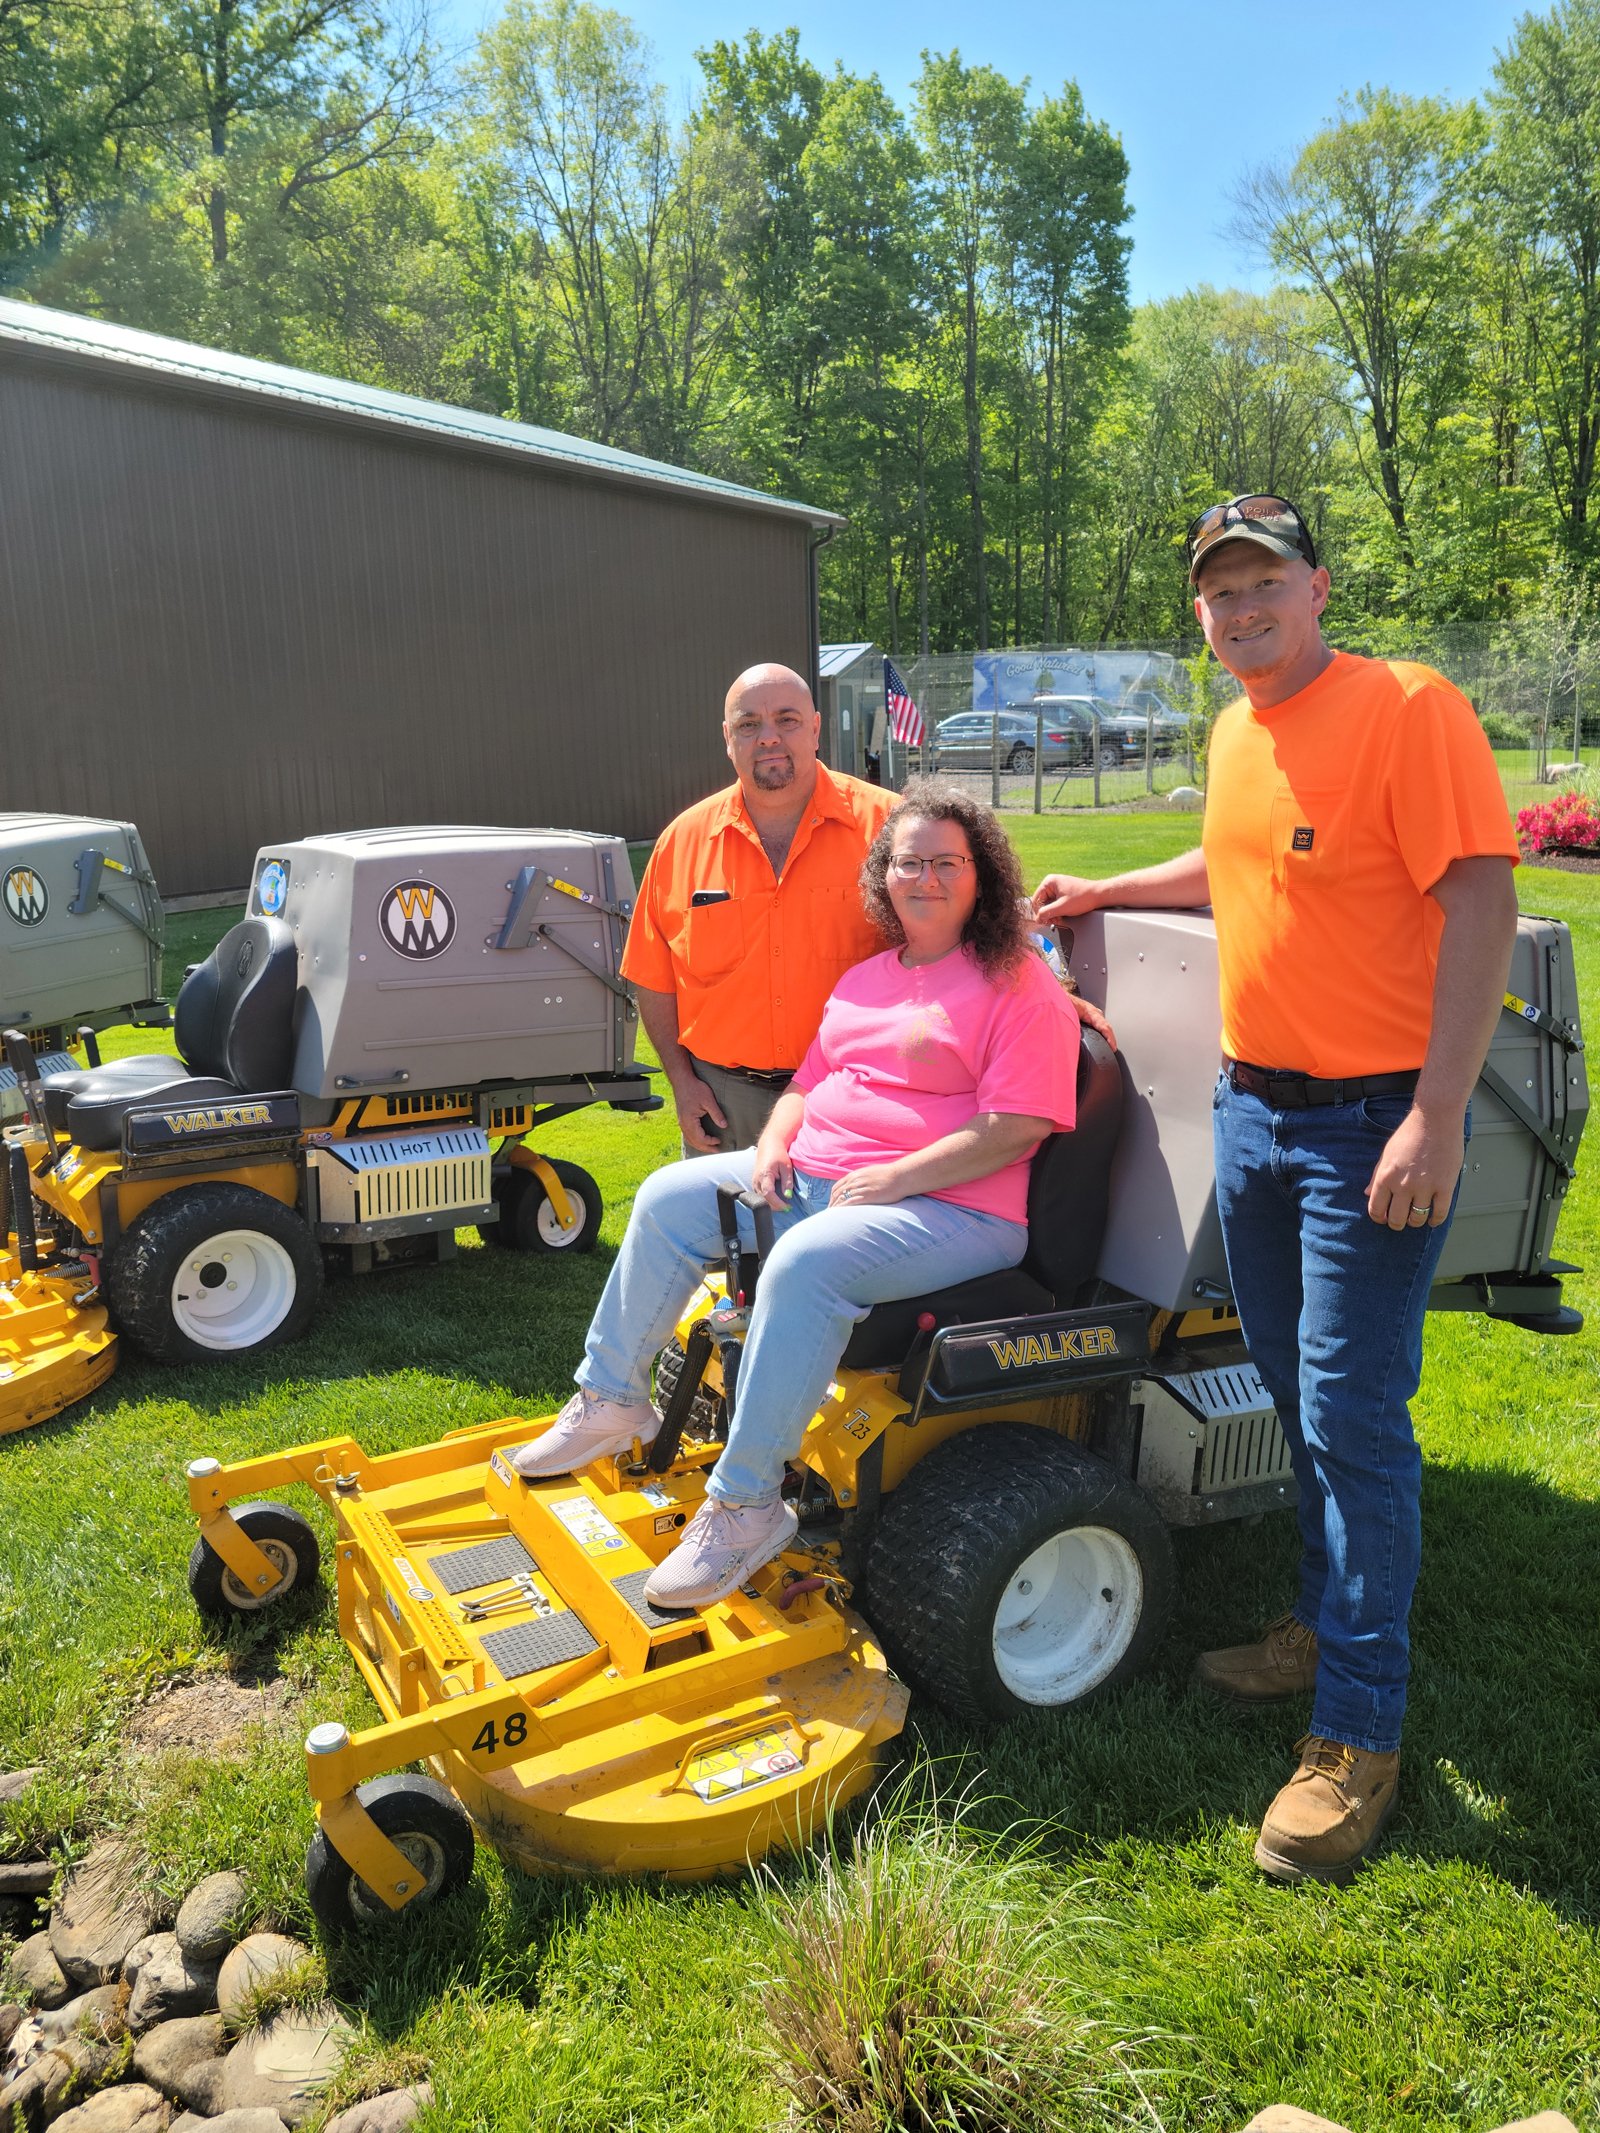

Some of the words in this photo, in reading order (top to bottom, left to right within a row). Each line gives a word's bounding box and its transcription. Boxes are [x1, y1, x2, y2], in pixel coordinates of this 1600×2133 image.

[1006, 660, 1035, 678] Good
[1035, 656, 1085, 676] Natured
[163, 1105, 272, 1134] WALKER
[400, 1142, 431, 1155] HOT
[987, 1326, 1119, 1370] WALKER
[472, 1712, 528, 1754] 48
